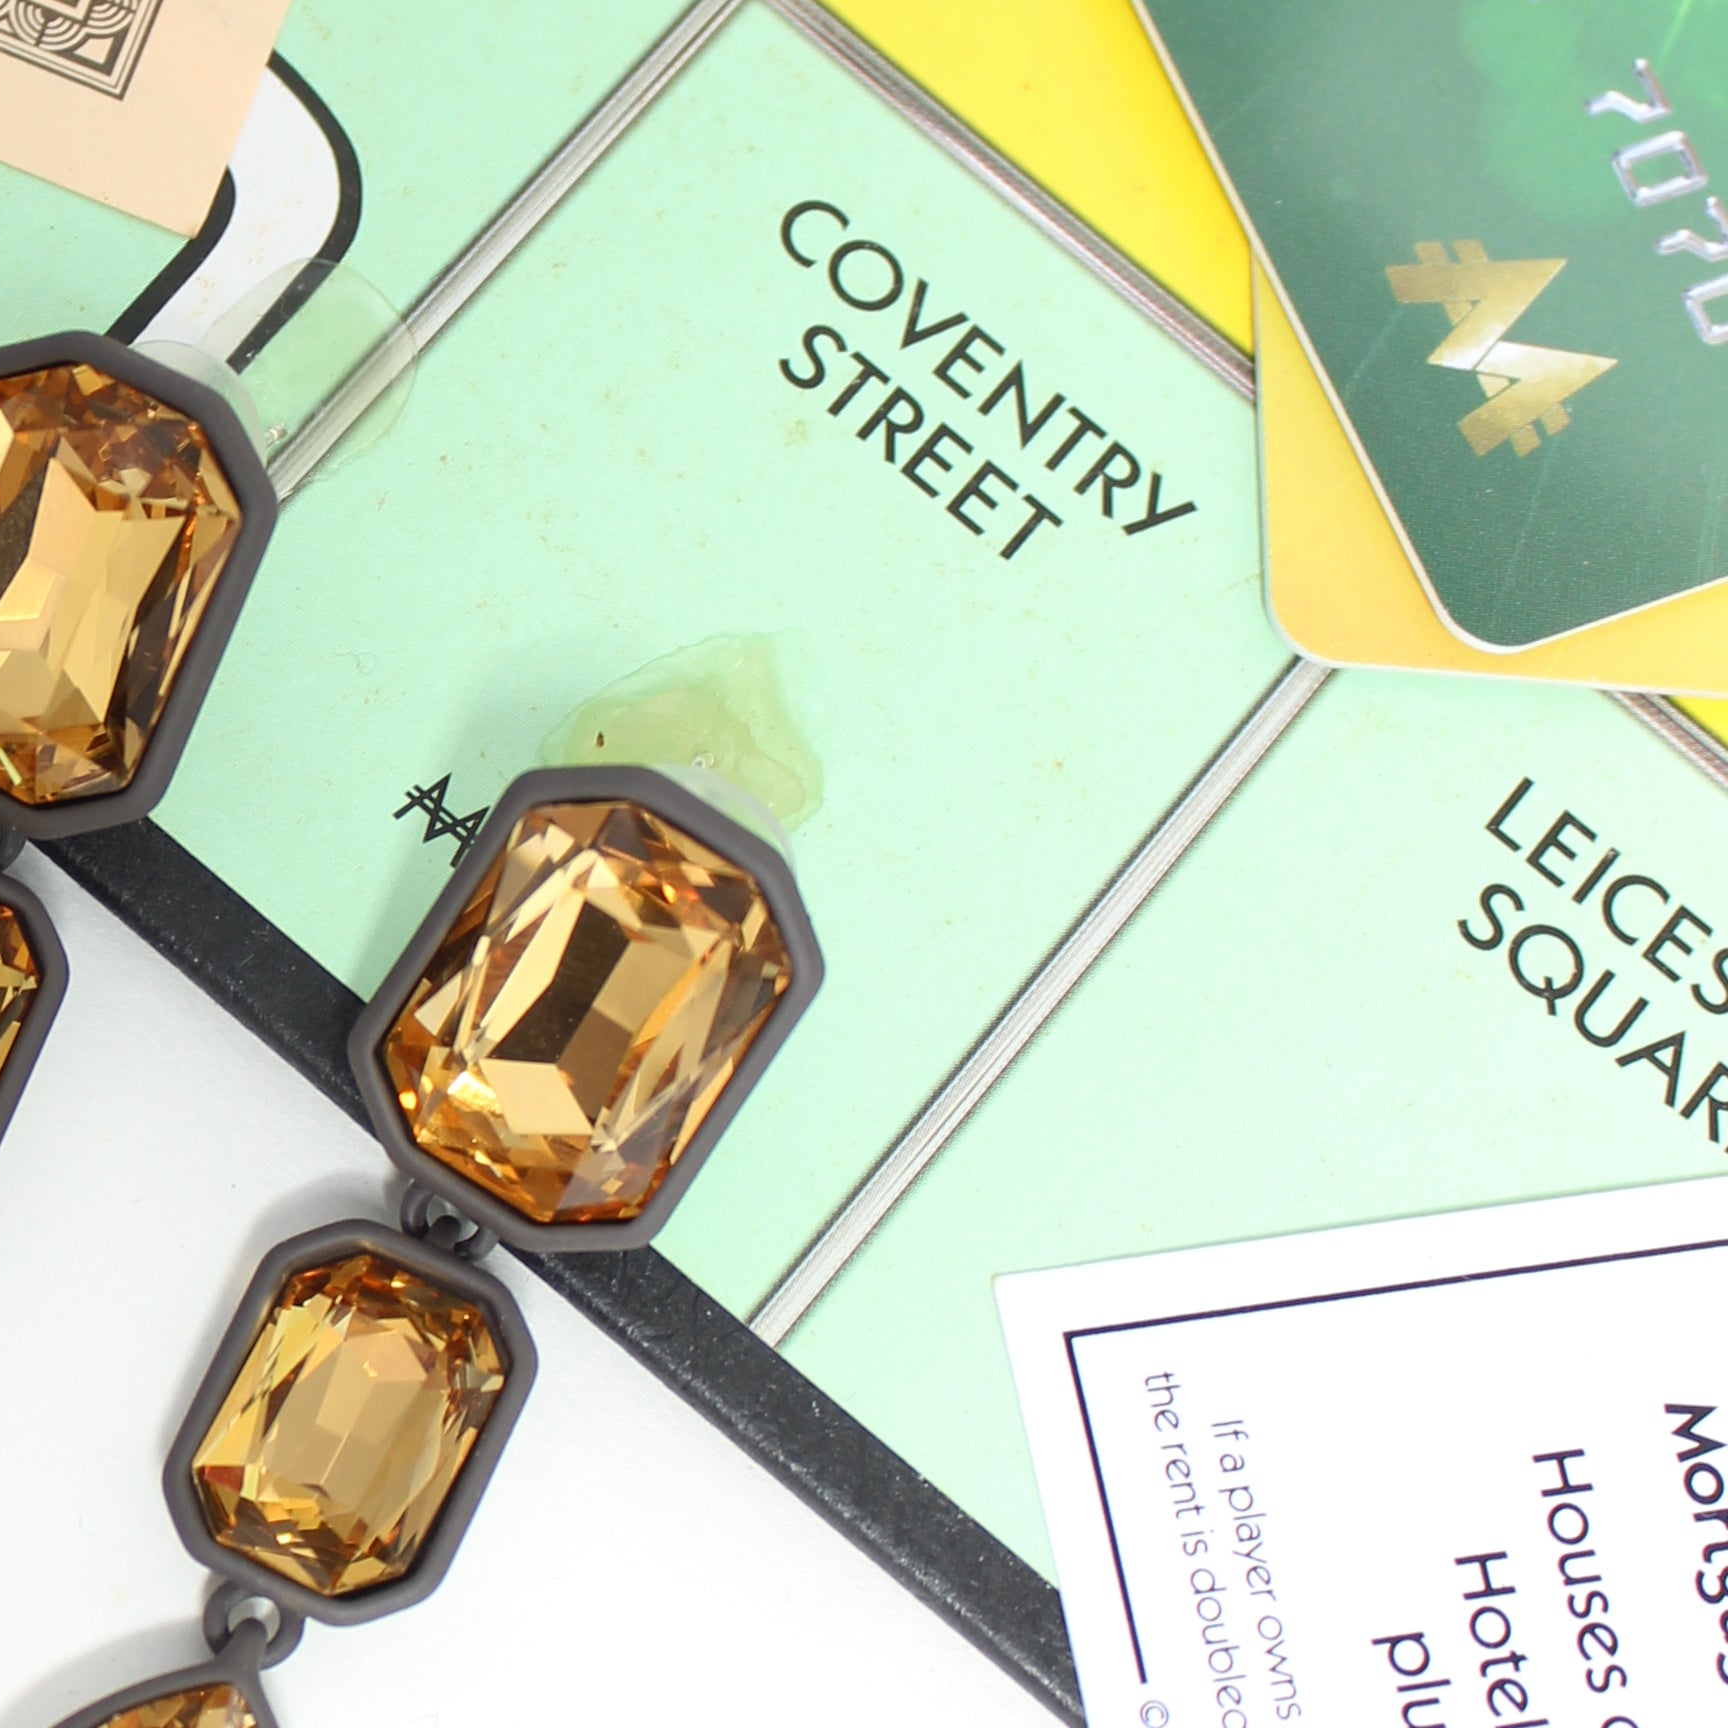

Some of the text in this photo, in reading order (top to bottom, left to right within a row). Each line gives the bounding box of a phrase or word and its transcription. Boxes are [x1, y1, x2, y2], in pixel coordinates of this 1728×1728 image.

[779, 199, 1198, 538] COVENTRY
[778, 323, 1064, 562] STREET
[1457, 883, 1728, 1154] SQUAR
[1144, 1371, 1181, 1432] the
[1211, 1419, 1249, 1440] If
[1161, 1443, 1206, 1520] rent
[1218, 1453, 1245, 1473] a
[1180, 1528, 1215, 1556] is
[1217, 1486, 1277, 1602] player
[1532, 1448, 1628, 1694] Houses
[1257, 1615, 1302, 1721] owns
